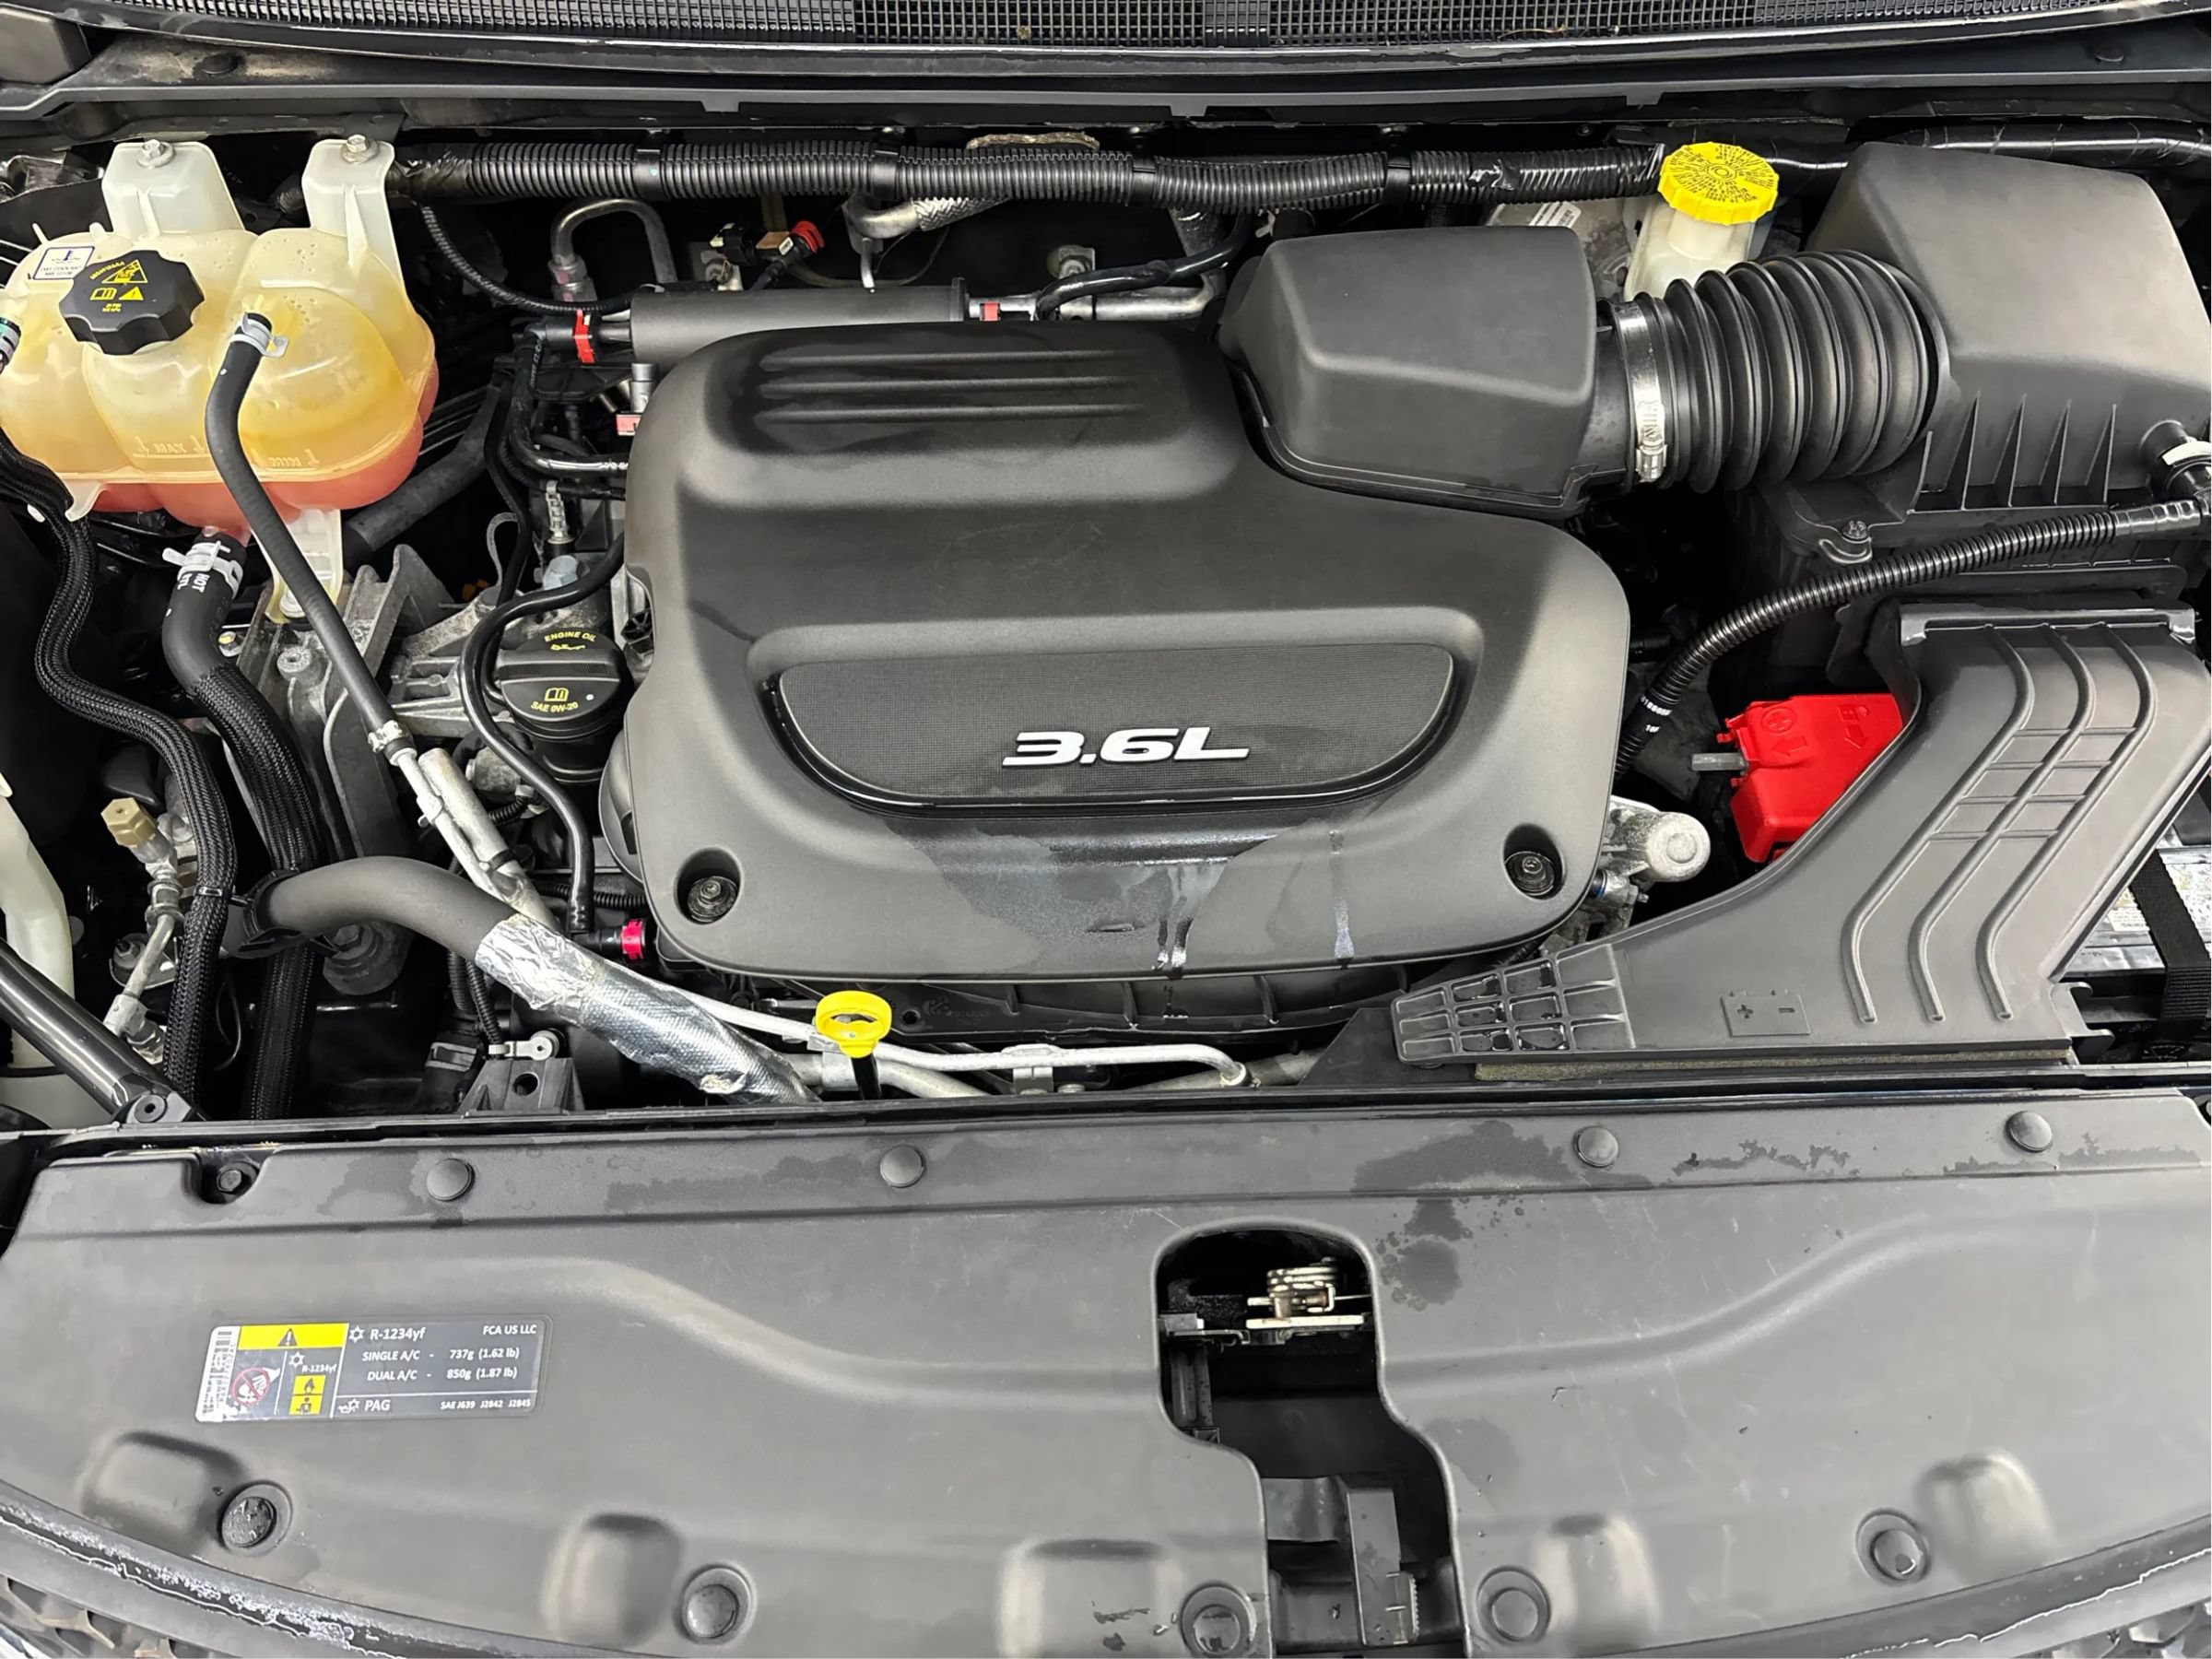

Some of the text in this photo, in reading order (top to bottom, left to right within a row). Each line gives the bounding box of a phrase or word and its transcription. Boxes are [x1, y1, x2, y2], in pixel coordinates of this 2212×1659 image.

[192, 572, 210, 594] HOT
[544, 631, 596, 642] ENGINE OIL
[531, 700, 579, 712] SAE 0W-20
[1002, 726, 1250, 766] 3.6L
[370, 1326, 426, 1341] R-1234yf
[483, 1324, 537, 1335] FCA US LLC
[362, 1351, 398, 1361] SINGLE
[400, 1349, 420, 1361] A/C
[450, 1349, 474, 1360] 737g
[478, 1348, 504, 1359] (1.62
[506, 1347, 520, 1359] lb)
[301, 1364, 337, 1374] R-1234yf
[368, 1371, 395, 1381] DUAL
[397, 1370, 418, 1381] A/C
[447, 1369, 471, 1380] 850g
[476, 1368, 502, 1380] (1.87
[504, 1367, 517, 1378] lb)
[364, 1399, 391, 1411] PAG
[440, 1401, 456, 1410] SAE
[457, 1400, 476, 1409] J639
